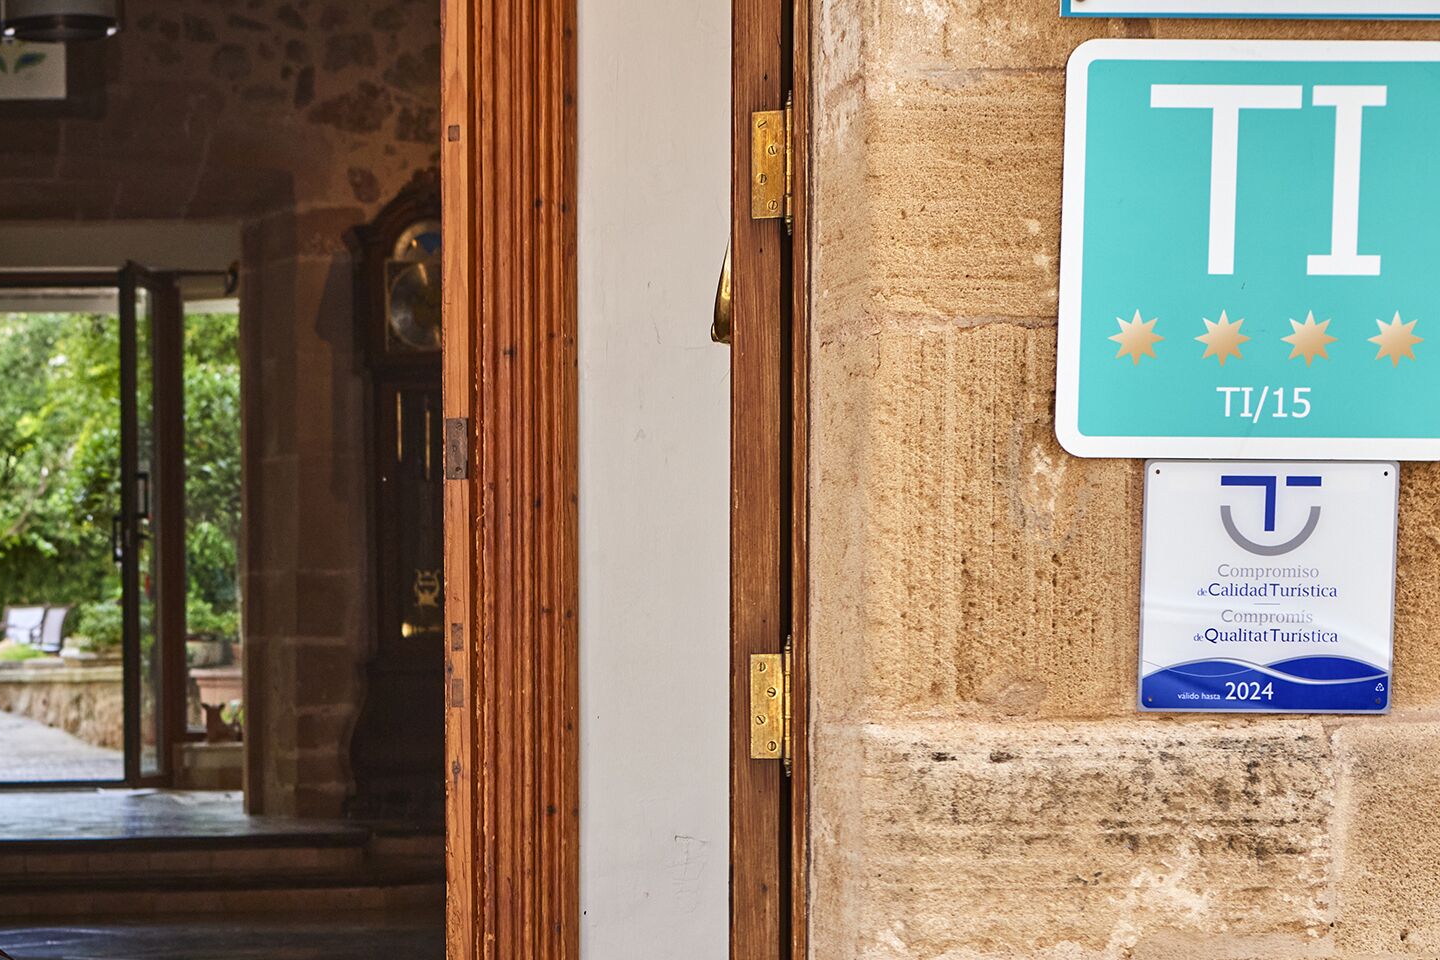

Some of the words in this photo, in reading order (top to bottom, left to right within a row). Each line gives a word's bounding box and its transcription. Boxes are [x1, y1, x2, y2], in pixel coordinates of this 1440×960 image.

[1150, 84, 1387, 276] TI
[1216, 386, 1312, 424] TI/15
[1217, 563, 1320, 580] Compromiso
[1208, 583, 1268, 597] Calidad
[1269, 583, 1338, 598] Turística
[1221, 609, 1313, 626] Compromís
[1204, 628, 1268, 644] Qualitat
[1269, 628, 1339, 643] Turística
[1201, 692, 1221, 700] hasta
[1225, 681, 1274, 701] 2024
